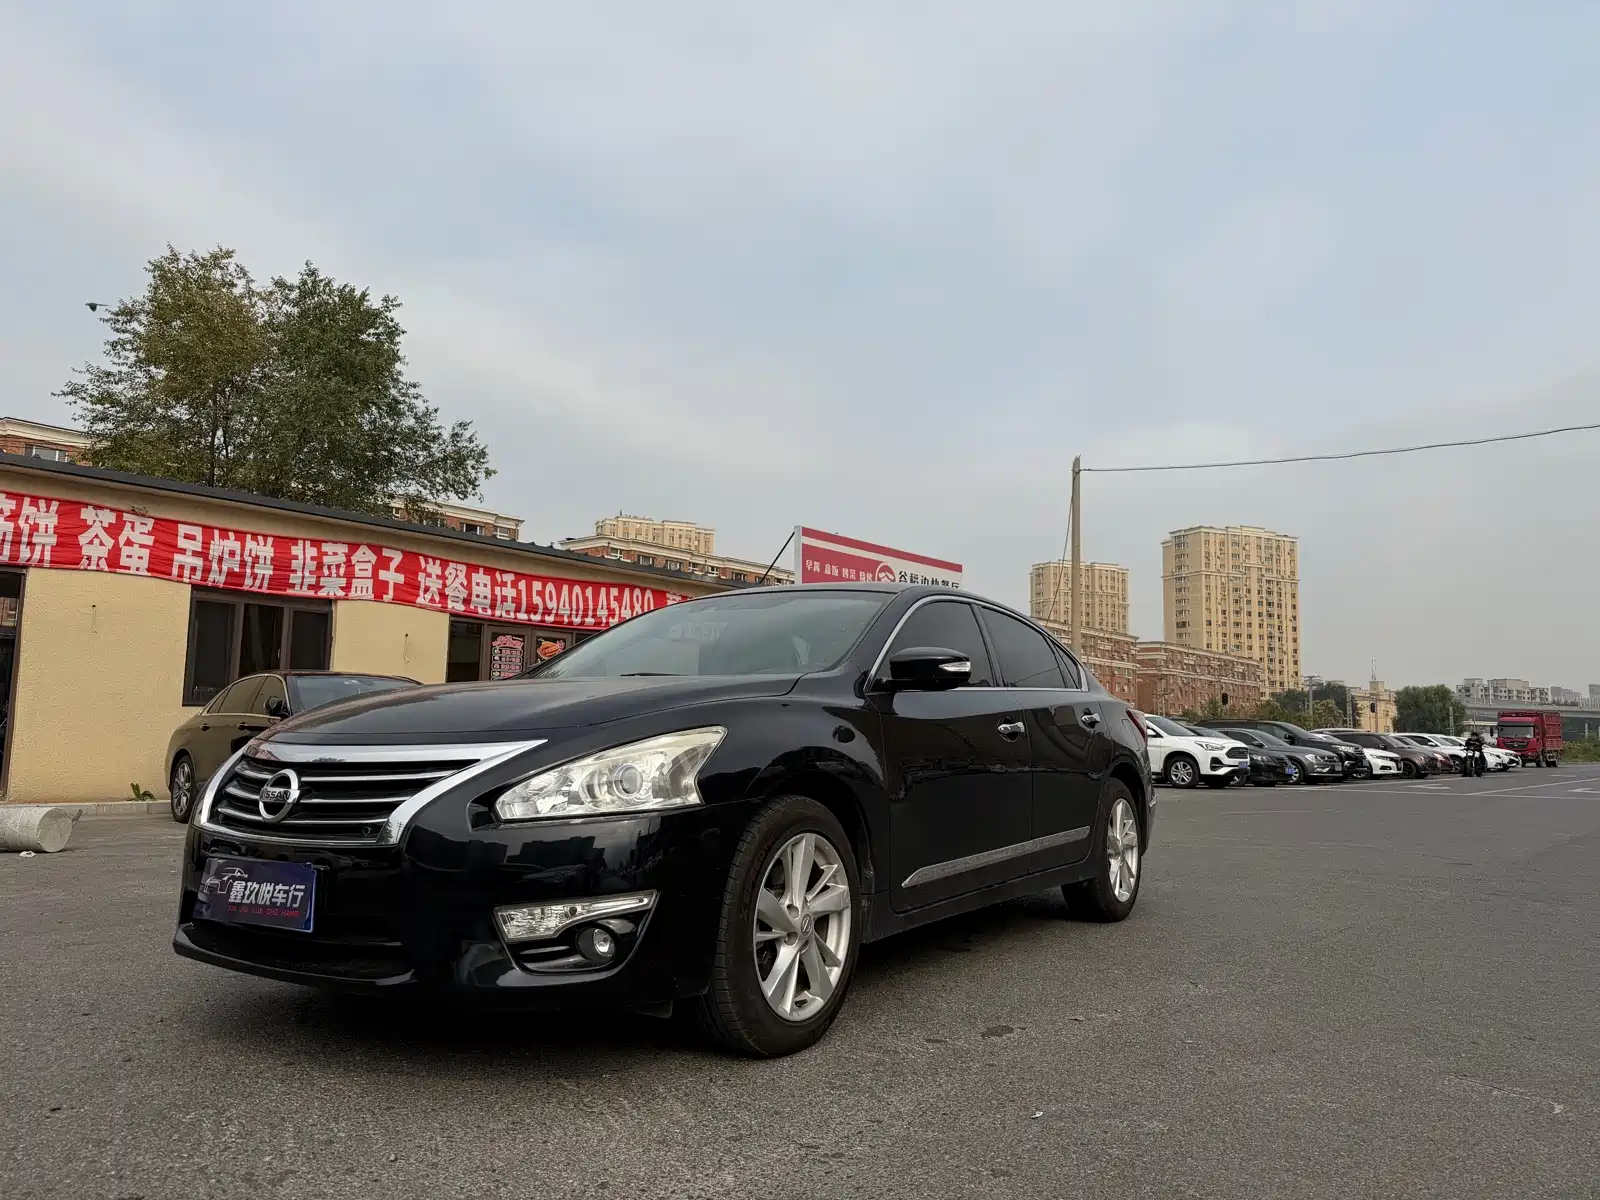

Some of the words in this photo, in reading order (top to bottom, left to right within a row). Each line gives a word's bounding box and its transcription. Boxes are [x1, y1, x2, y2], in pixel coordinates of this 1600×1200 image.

[78, 505, 155, 576] 茶蛋
[171, 523, 274, 591] 吊炉饼
[288, 540, 405, 602] 韭菜盒子
[416, 556, 654, 628] 送餐电话15940145480
[228, 881, 306, 907] 鑫玖悦车行
